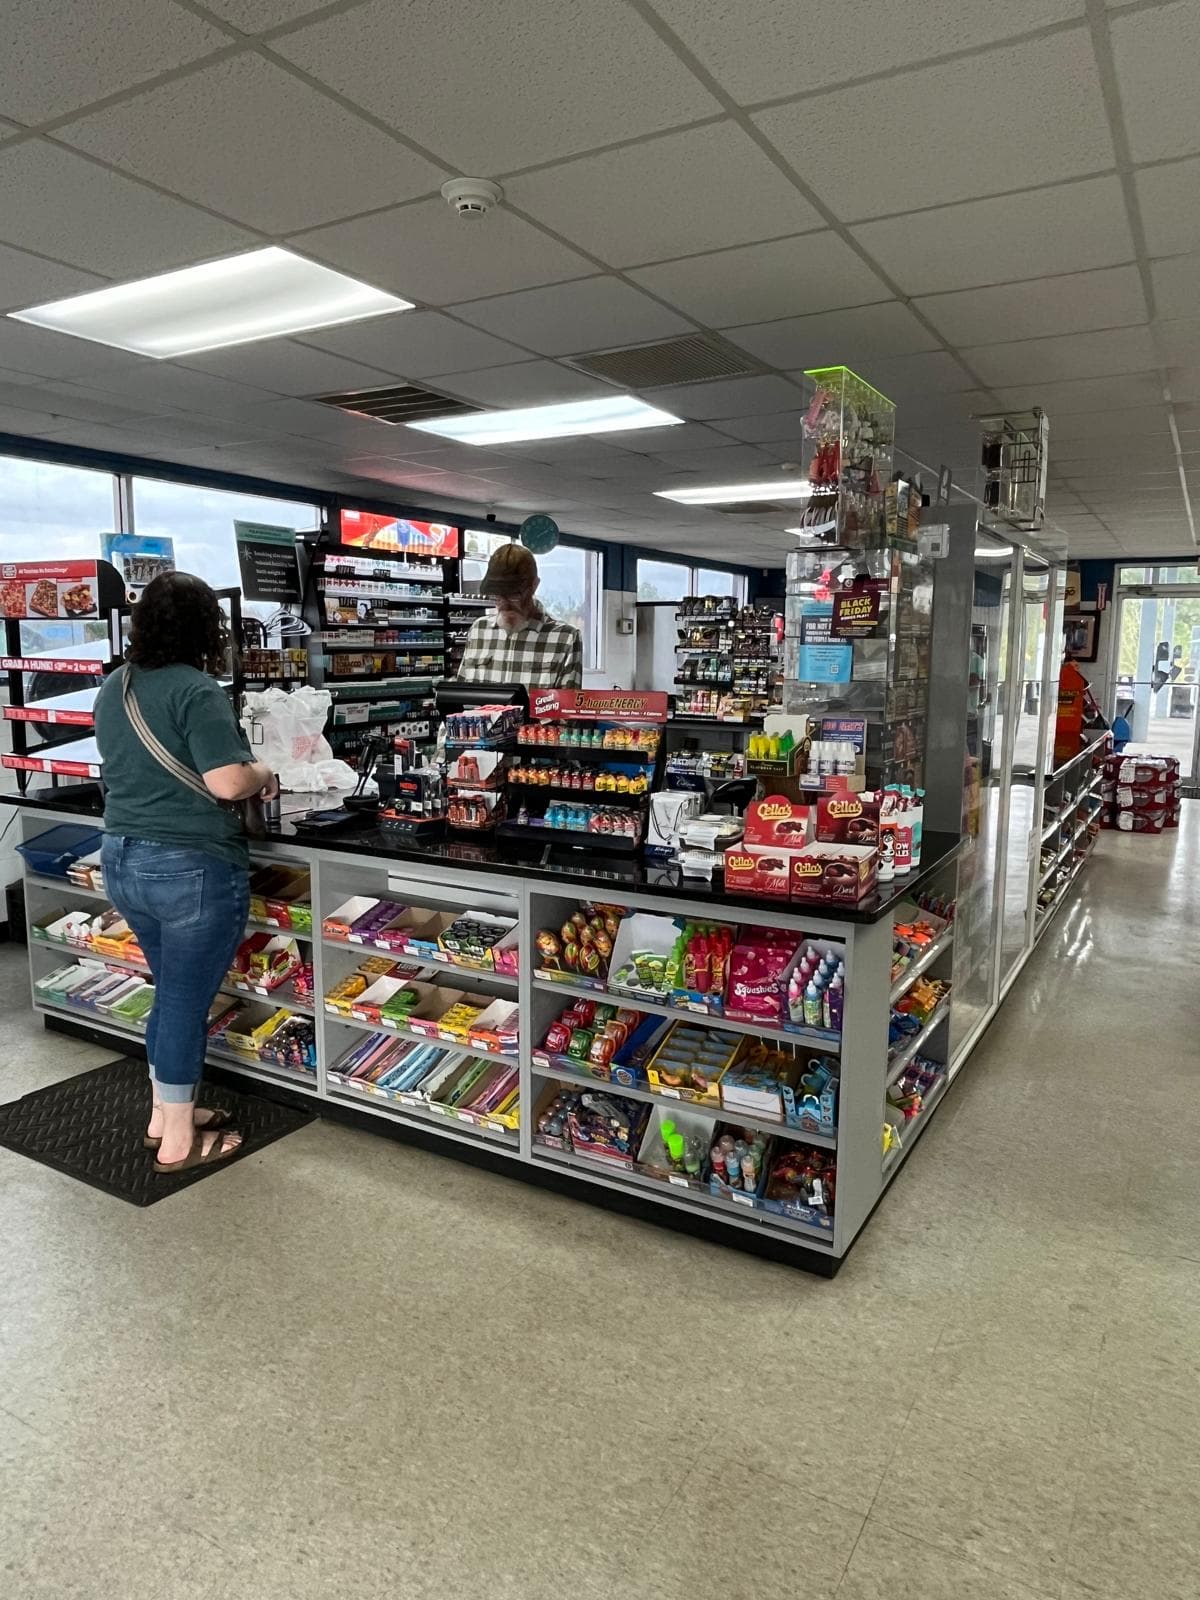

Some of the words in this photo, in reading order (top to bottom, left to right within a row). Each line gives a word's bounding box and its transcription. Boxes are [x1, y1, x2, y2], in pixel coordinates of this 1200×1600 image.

[840, 598, 871, 608] BLACK
[839, 606, 872, 616] FRIDAY
[2, 660, 23, 669] GRAB
[23, 661, 29, 669] A
[74, 663, 79, 671] 2
[536, 693, 555, 706] Great
[535, 702, 559, 715] Tasting
[757, 803, 792, 820] Cella's
[827, 801, 862, 818] Cella's
[728, 856, 755, 870] Cella's
[794, 862, 823, 876] Cella's
[832, 884, 856, 896] Dark
